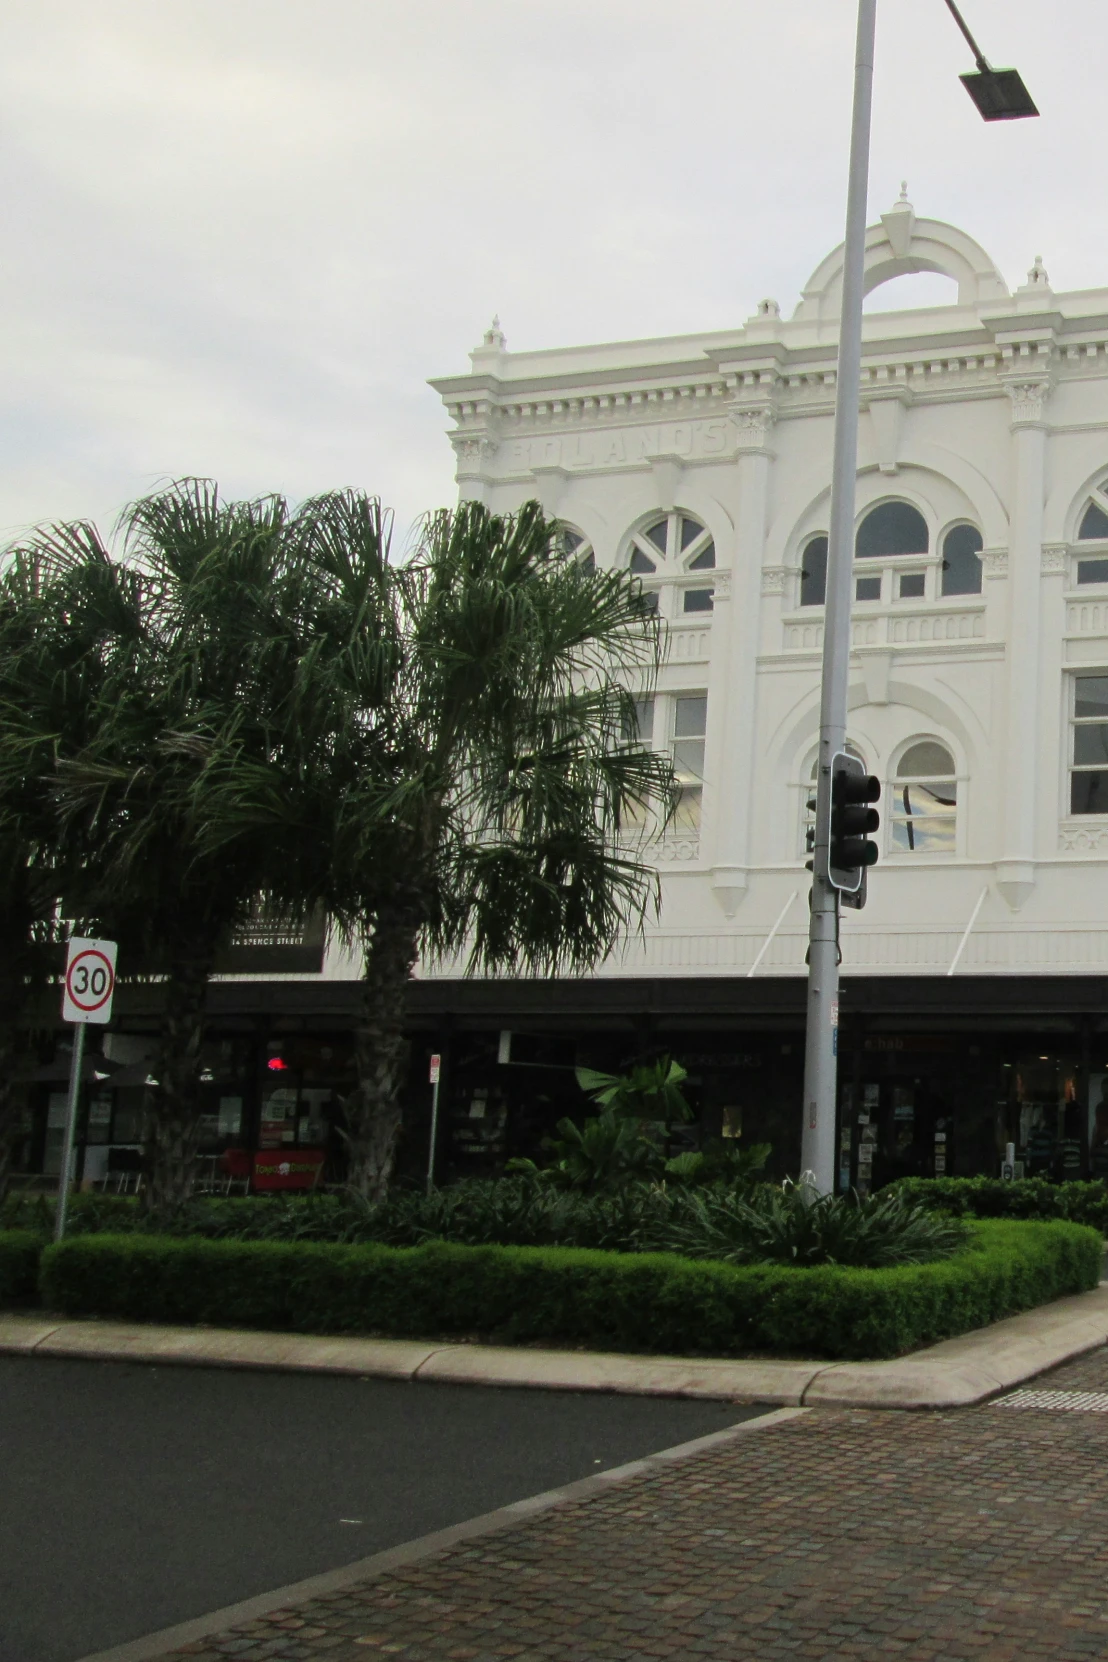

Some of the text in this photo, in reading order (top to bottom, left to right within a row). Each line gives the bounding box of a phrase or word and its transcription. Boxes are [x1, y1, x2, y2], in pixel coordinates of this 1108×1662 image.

[509, 423, 727, 471] BOLAND'S
[243, 937, 273, 945] SPENCE
[276, 937, 303, 945] STREET
[74, 966, 106, 996] 30
